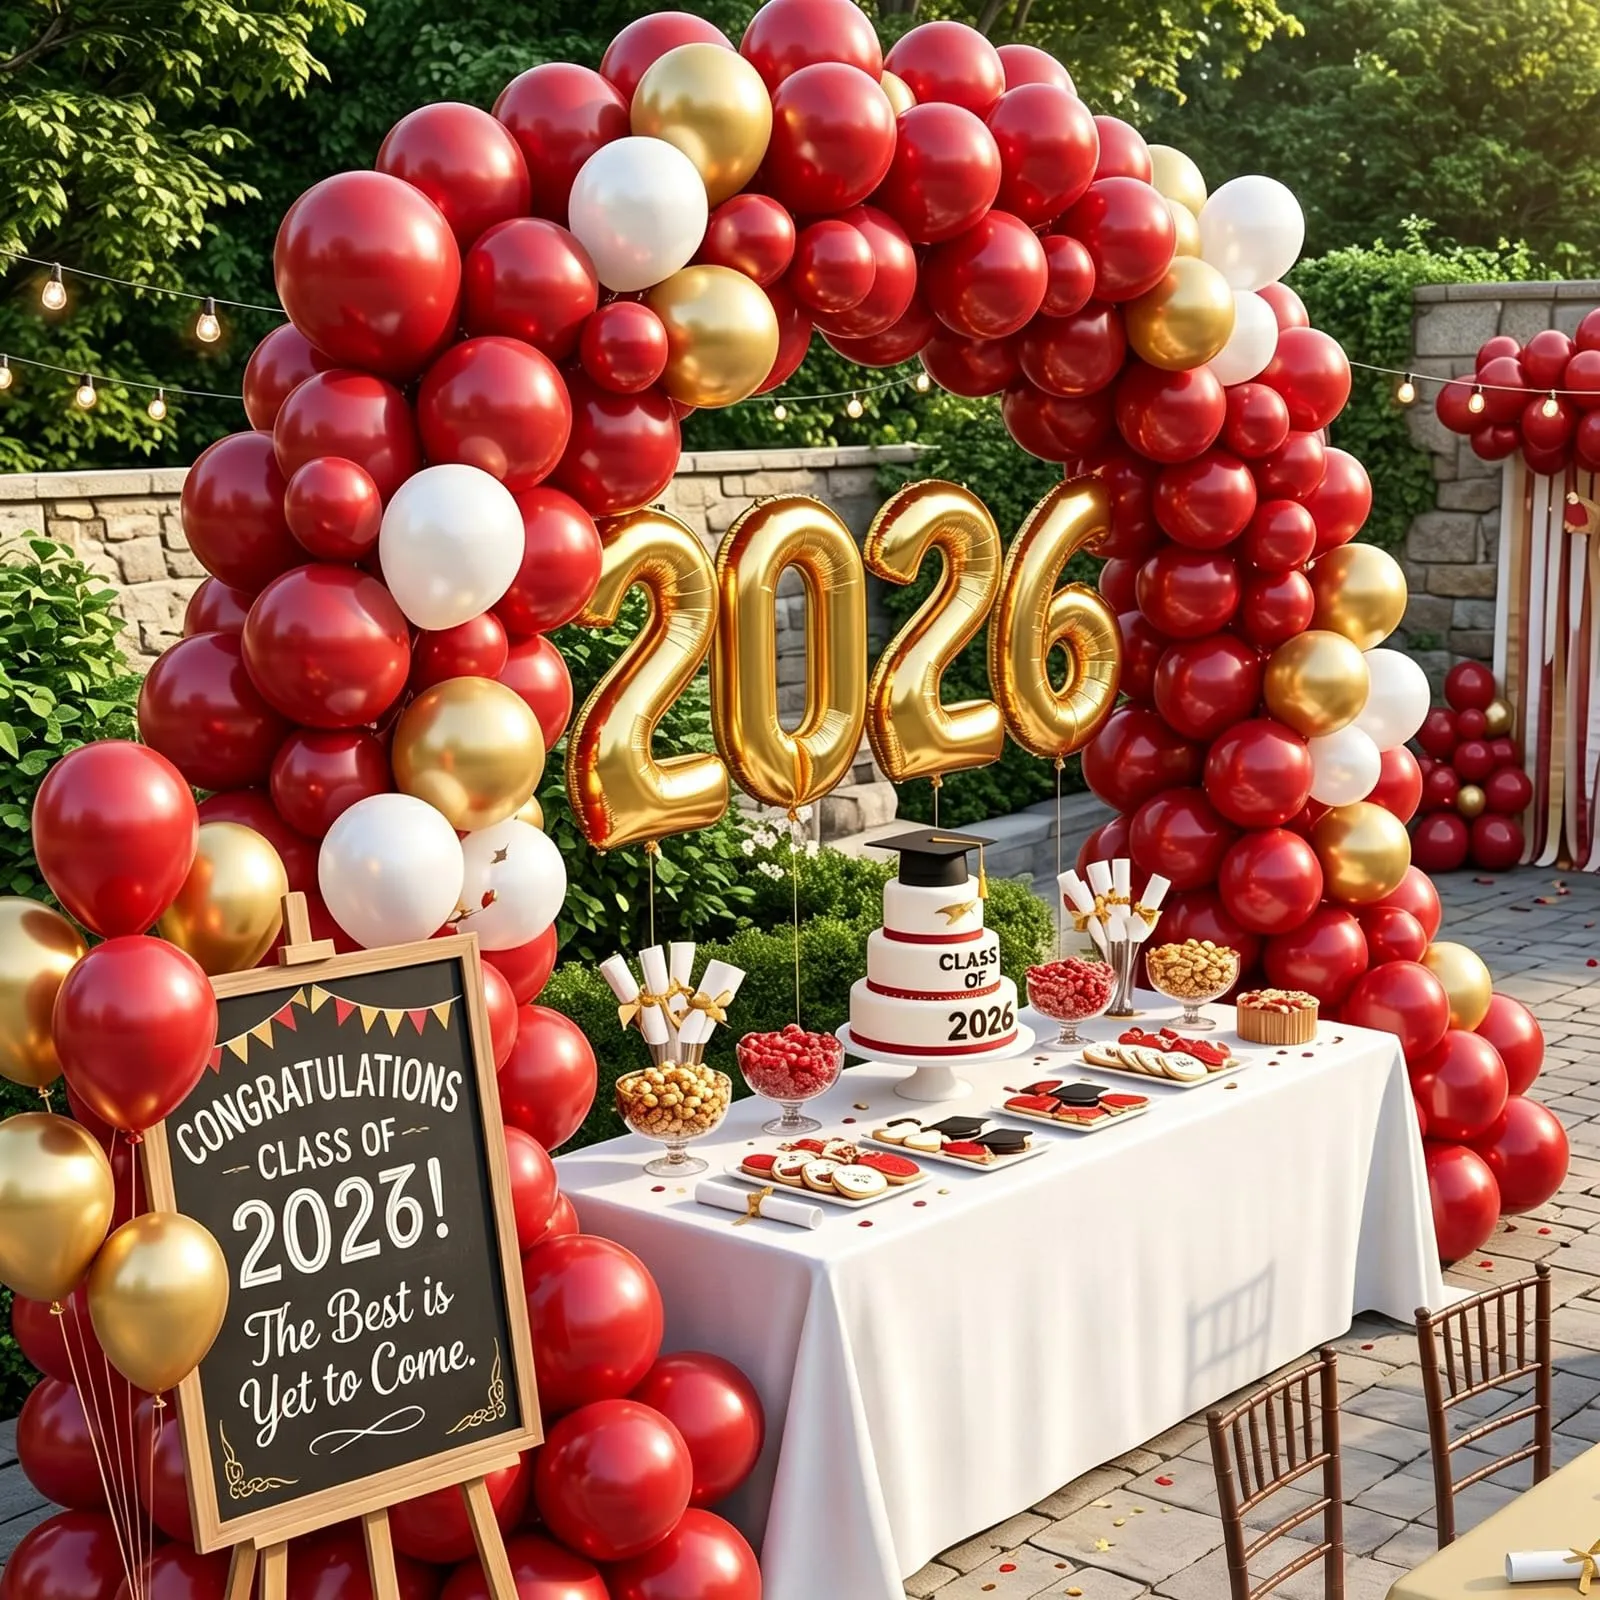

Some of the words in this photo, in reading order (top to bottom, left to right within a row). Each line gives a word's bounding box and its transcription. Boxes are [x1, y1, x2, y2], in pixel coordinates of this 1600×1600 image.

[566, 474, 1122, 851] 2026
[939, 946, 997, 971] CLASS
[964, 970, 987, 989] OF
[948, 1001, 1014, 1042] 2026
[176, 1052, 463, 1165] CONGRATULATIONS
[257, 1127, 352, 1180] CLASS
[361, 1116, 396, 1157] OF
[244, 1301, 321, 1367] The
[328, 1280, 416, 1344] Best
[423, 1275, 455, 1317] is
[239, 1370, 317, 1448] Yet
[322, 1363, 363, 1407] to
[371, 1340, 477, 1396] Come.
